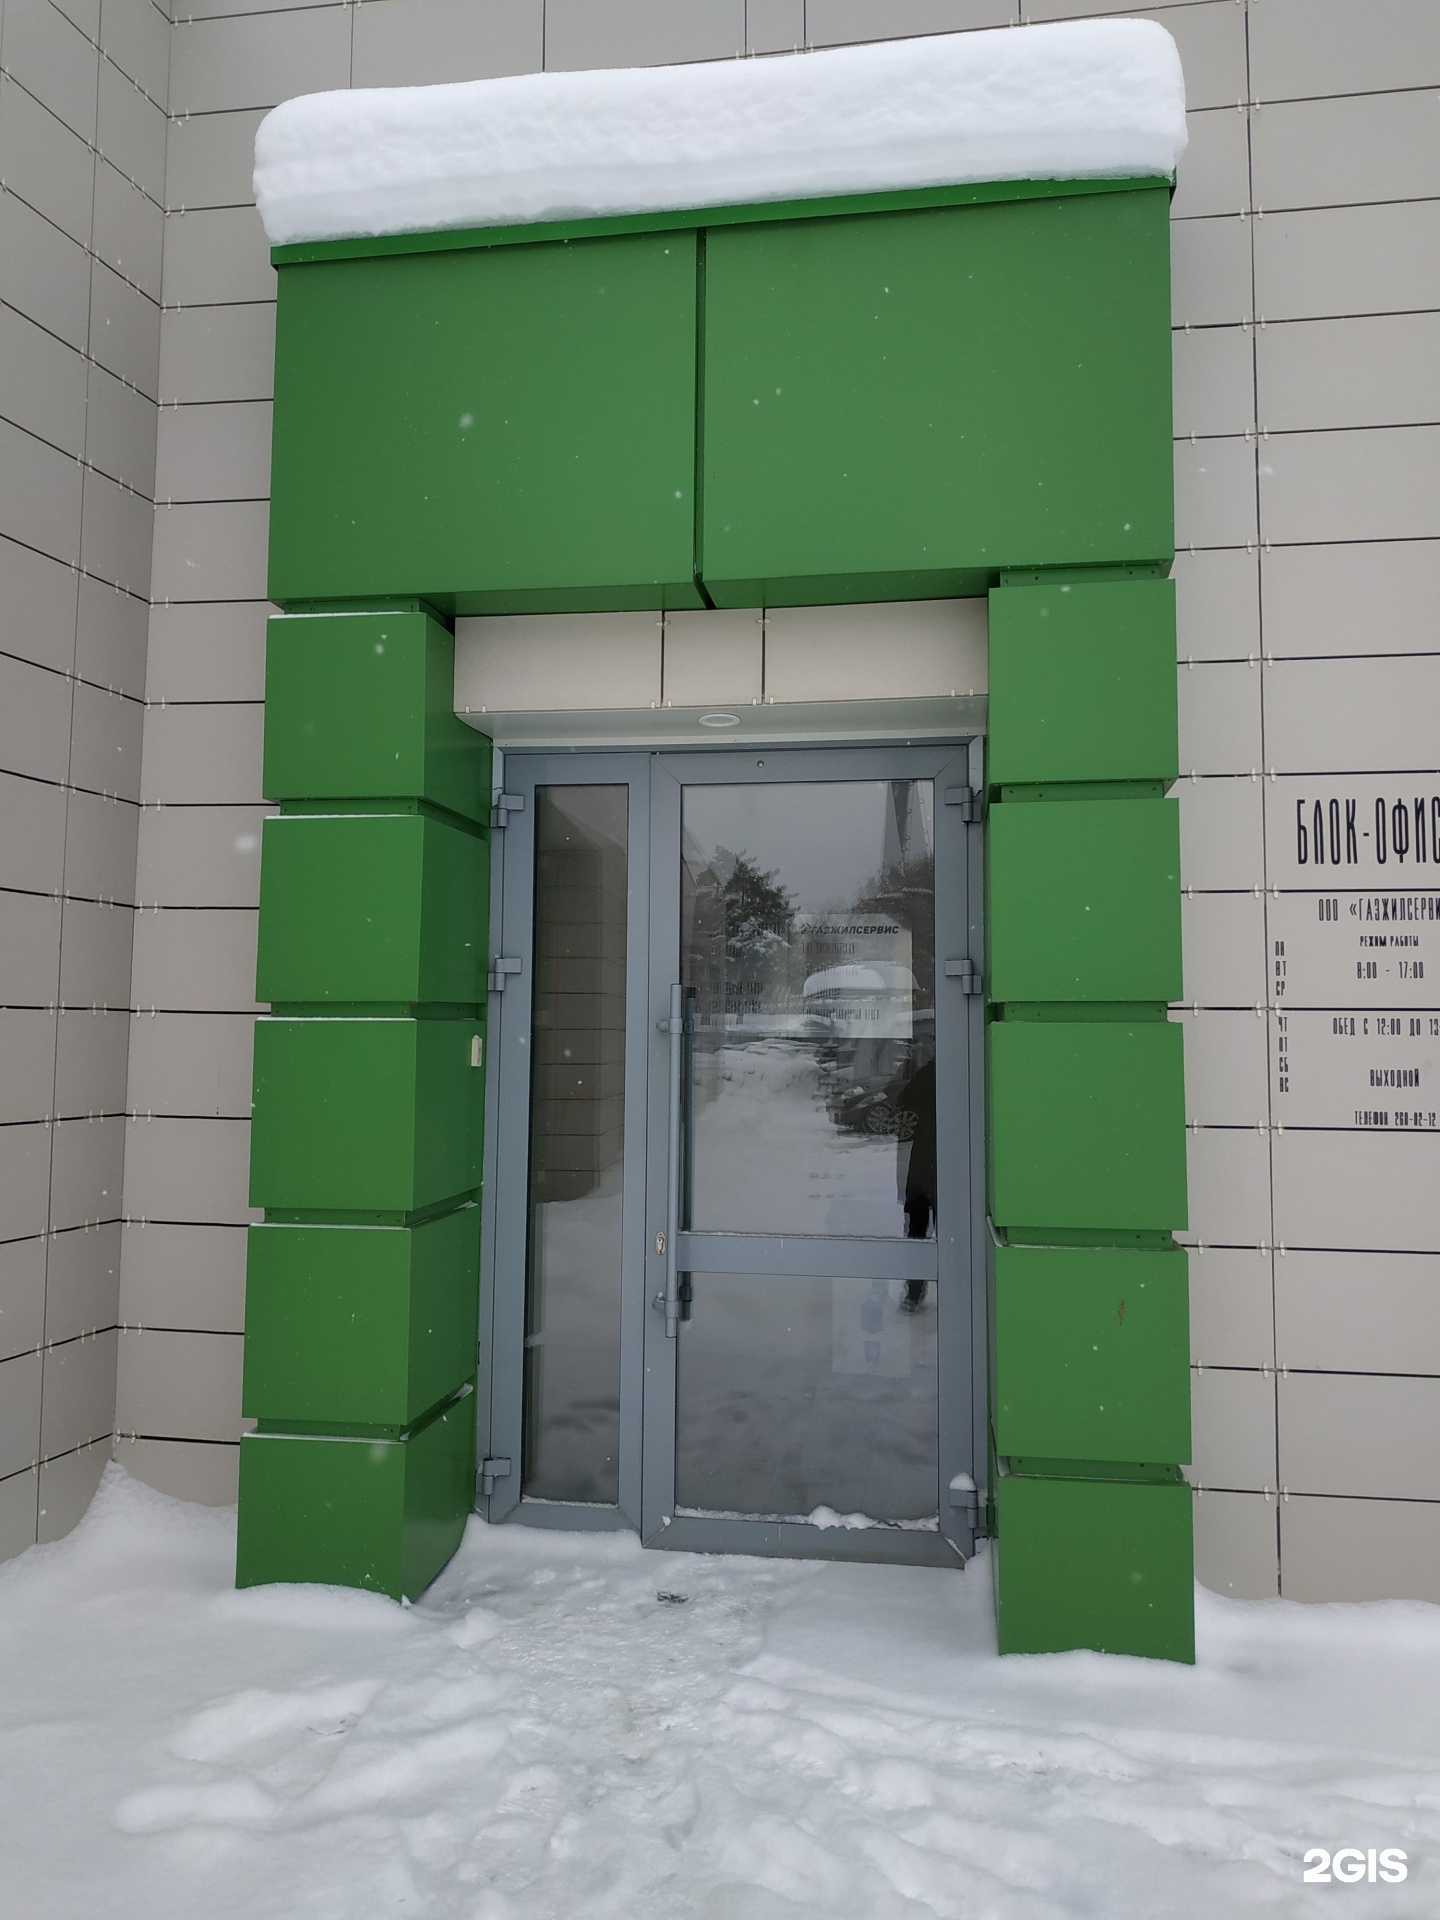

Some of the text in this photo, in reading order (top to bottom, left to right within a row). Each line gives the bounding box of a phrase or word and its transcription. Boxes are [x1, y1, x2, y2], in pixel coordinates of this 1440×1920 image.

[1296, 796, 1440, 865] БЛОК-ОФИС
[1318, 899, 1338, 921] ООО
[1360, 935, 1419, 947] РЕЖИМ РАБОТЫ
[1276, 961, 1287, 976] ВТ
[1357, 962, 1377, 979] 8:00
[1399, 961, 1424, 979] 17:00
[1276, 981, 1286, 996] СР
[1279, 1016, 1288, 1032] ЧТ
[1333, 1018, 1356, 1036] ОБЕД
[1363, 1018, 1369, 1035] С
[1377, 1018, 1401, 1036] 12:00
[1410, 1018, 1421, 1037] ДО
[1279, 1057, 1289, 1072] СБ
[1280, 1077, 1289, 1092] ВС
[1370, 1069, 1420, 1088] ВЫХОДНОЙ
[1355, 1111, 1389, 1126] ТЕЛЕФОН
